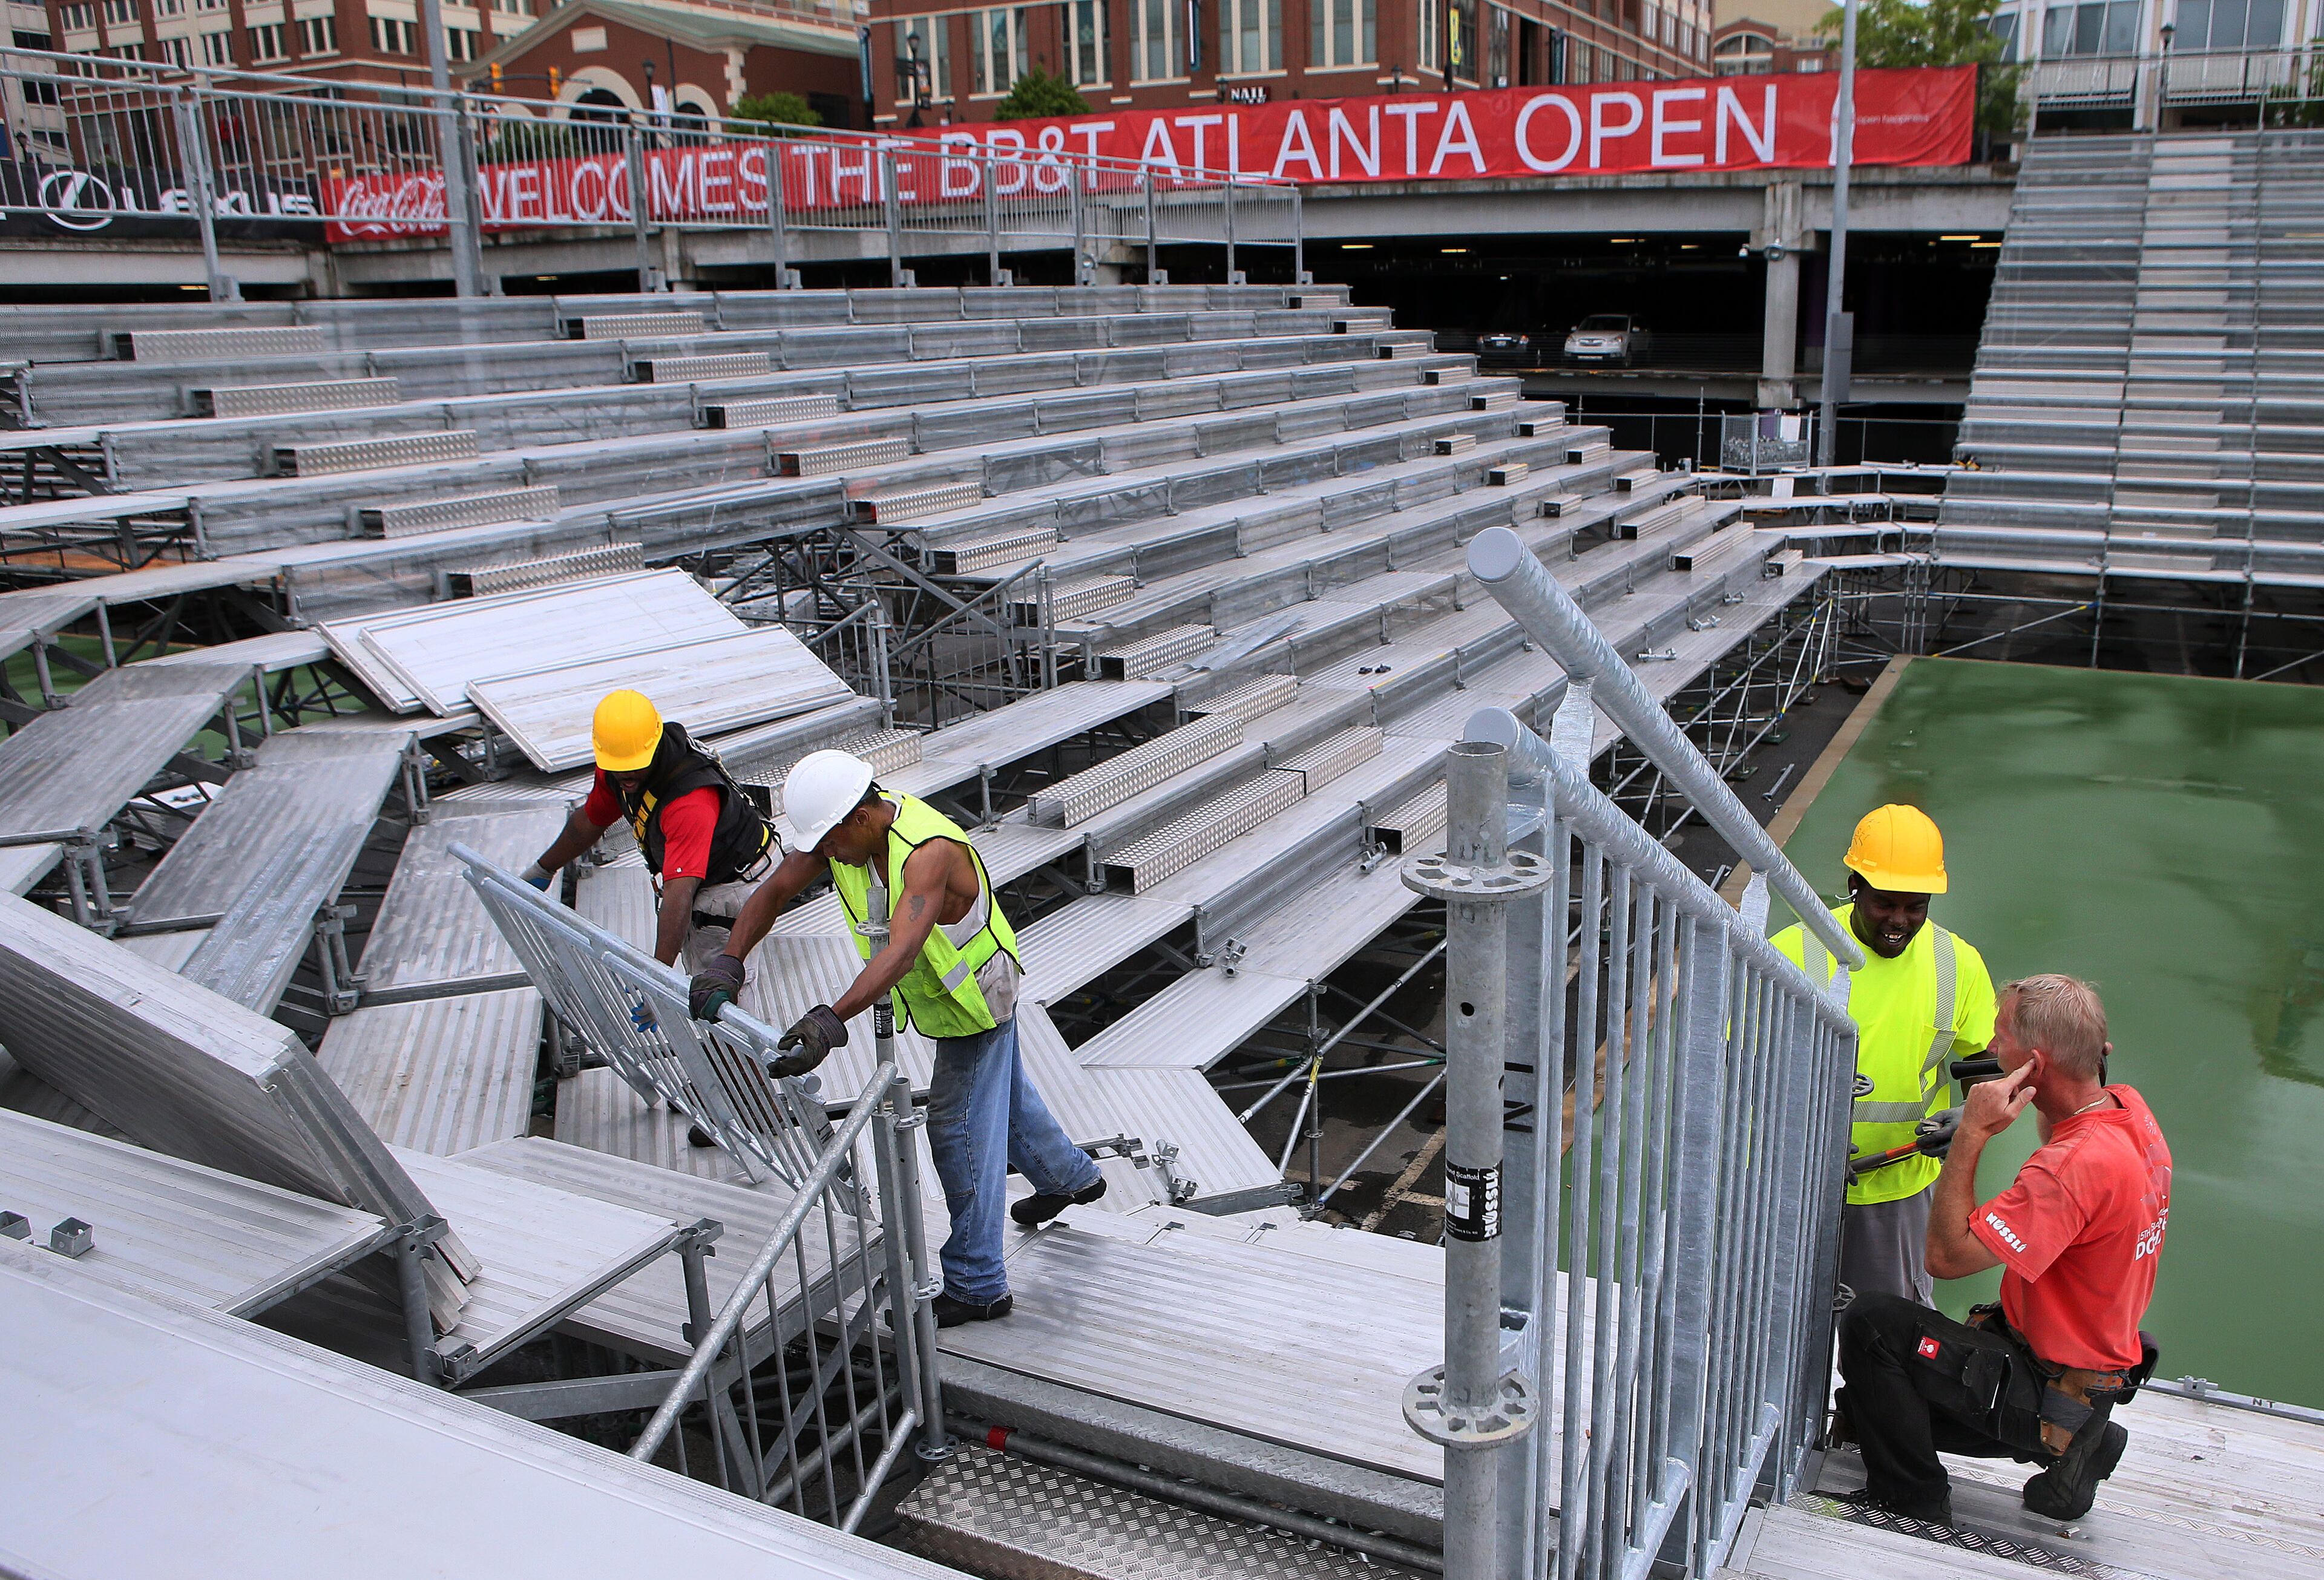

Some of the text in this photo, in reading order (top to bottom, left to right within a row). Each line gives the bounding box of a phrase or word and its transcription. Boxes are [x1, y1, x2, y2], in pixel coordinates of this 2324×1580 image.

[791, 139, 915, 206] THE
[940, 120, 1115, 198] BB&T
[1133, 100, 1487, 185] ATLANTA
[1514, 83, 1777, 172] OPEN
